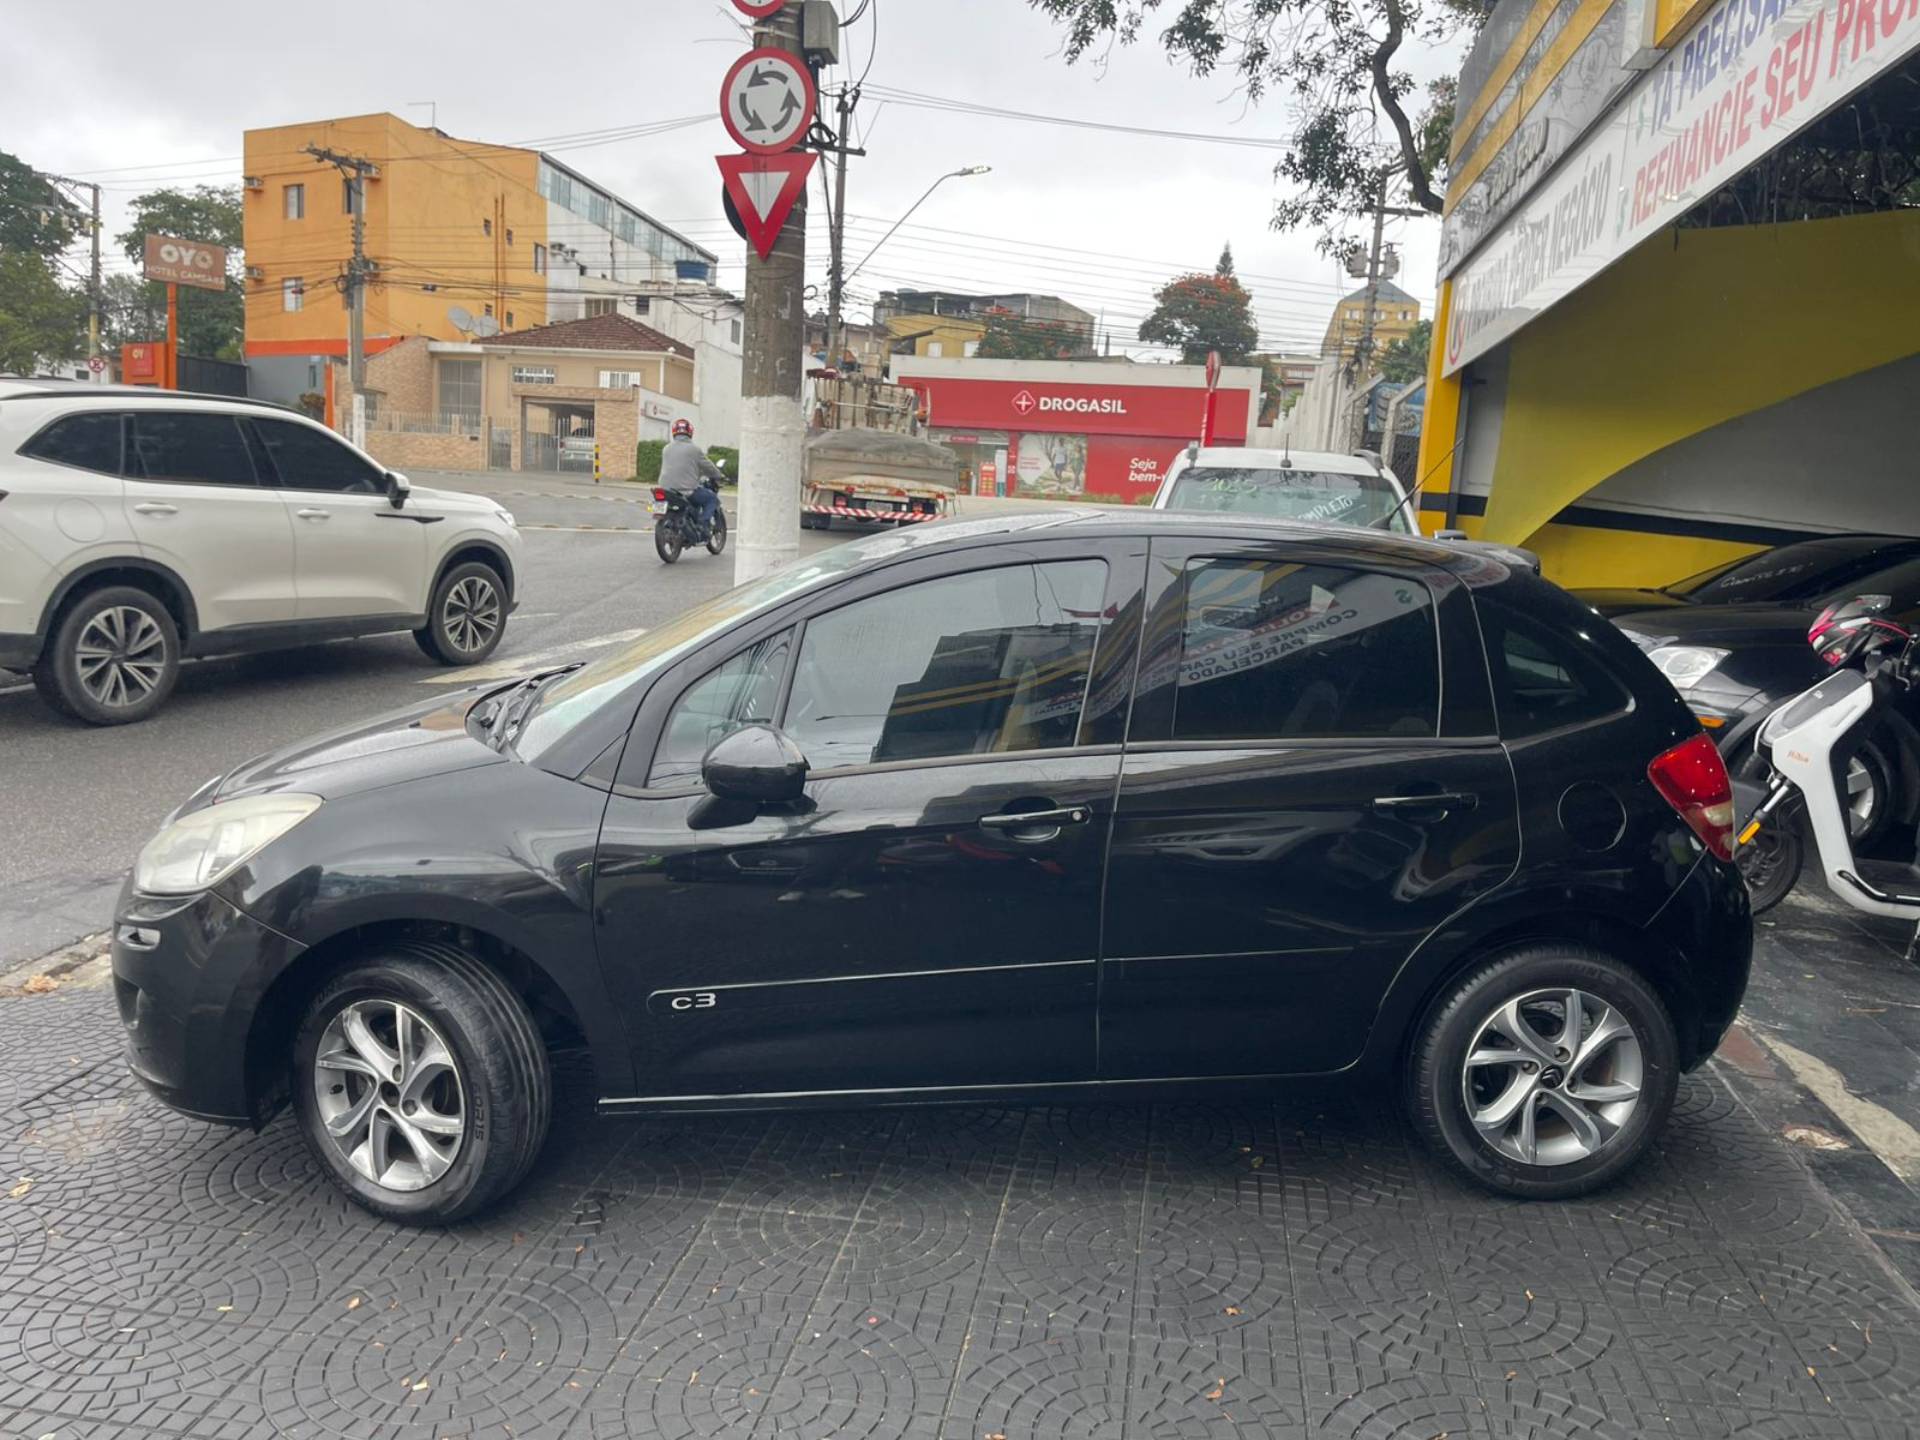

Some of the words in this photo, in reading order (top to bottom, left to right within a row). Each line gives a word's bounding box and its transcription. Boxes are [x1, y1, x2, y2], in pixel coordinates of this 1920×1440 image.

[1677, 0, 1797, 113] PRECISA
[1628, 66, 1758, 231] REFINANCIE
[1761, 8, 1824, 131] SEU
[160, 244, 213, 269] OYO
[146, 264, 177, 279] HOTEL
[1039, 397, 1127, 414] DROGASIL
[1129, 457, 1157, 472] Seja
[671, 992, 716, 1010] C3
